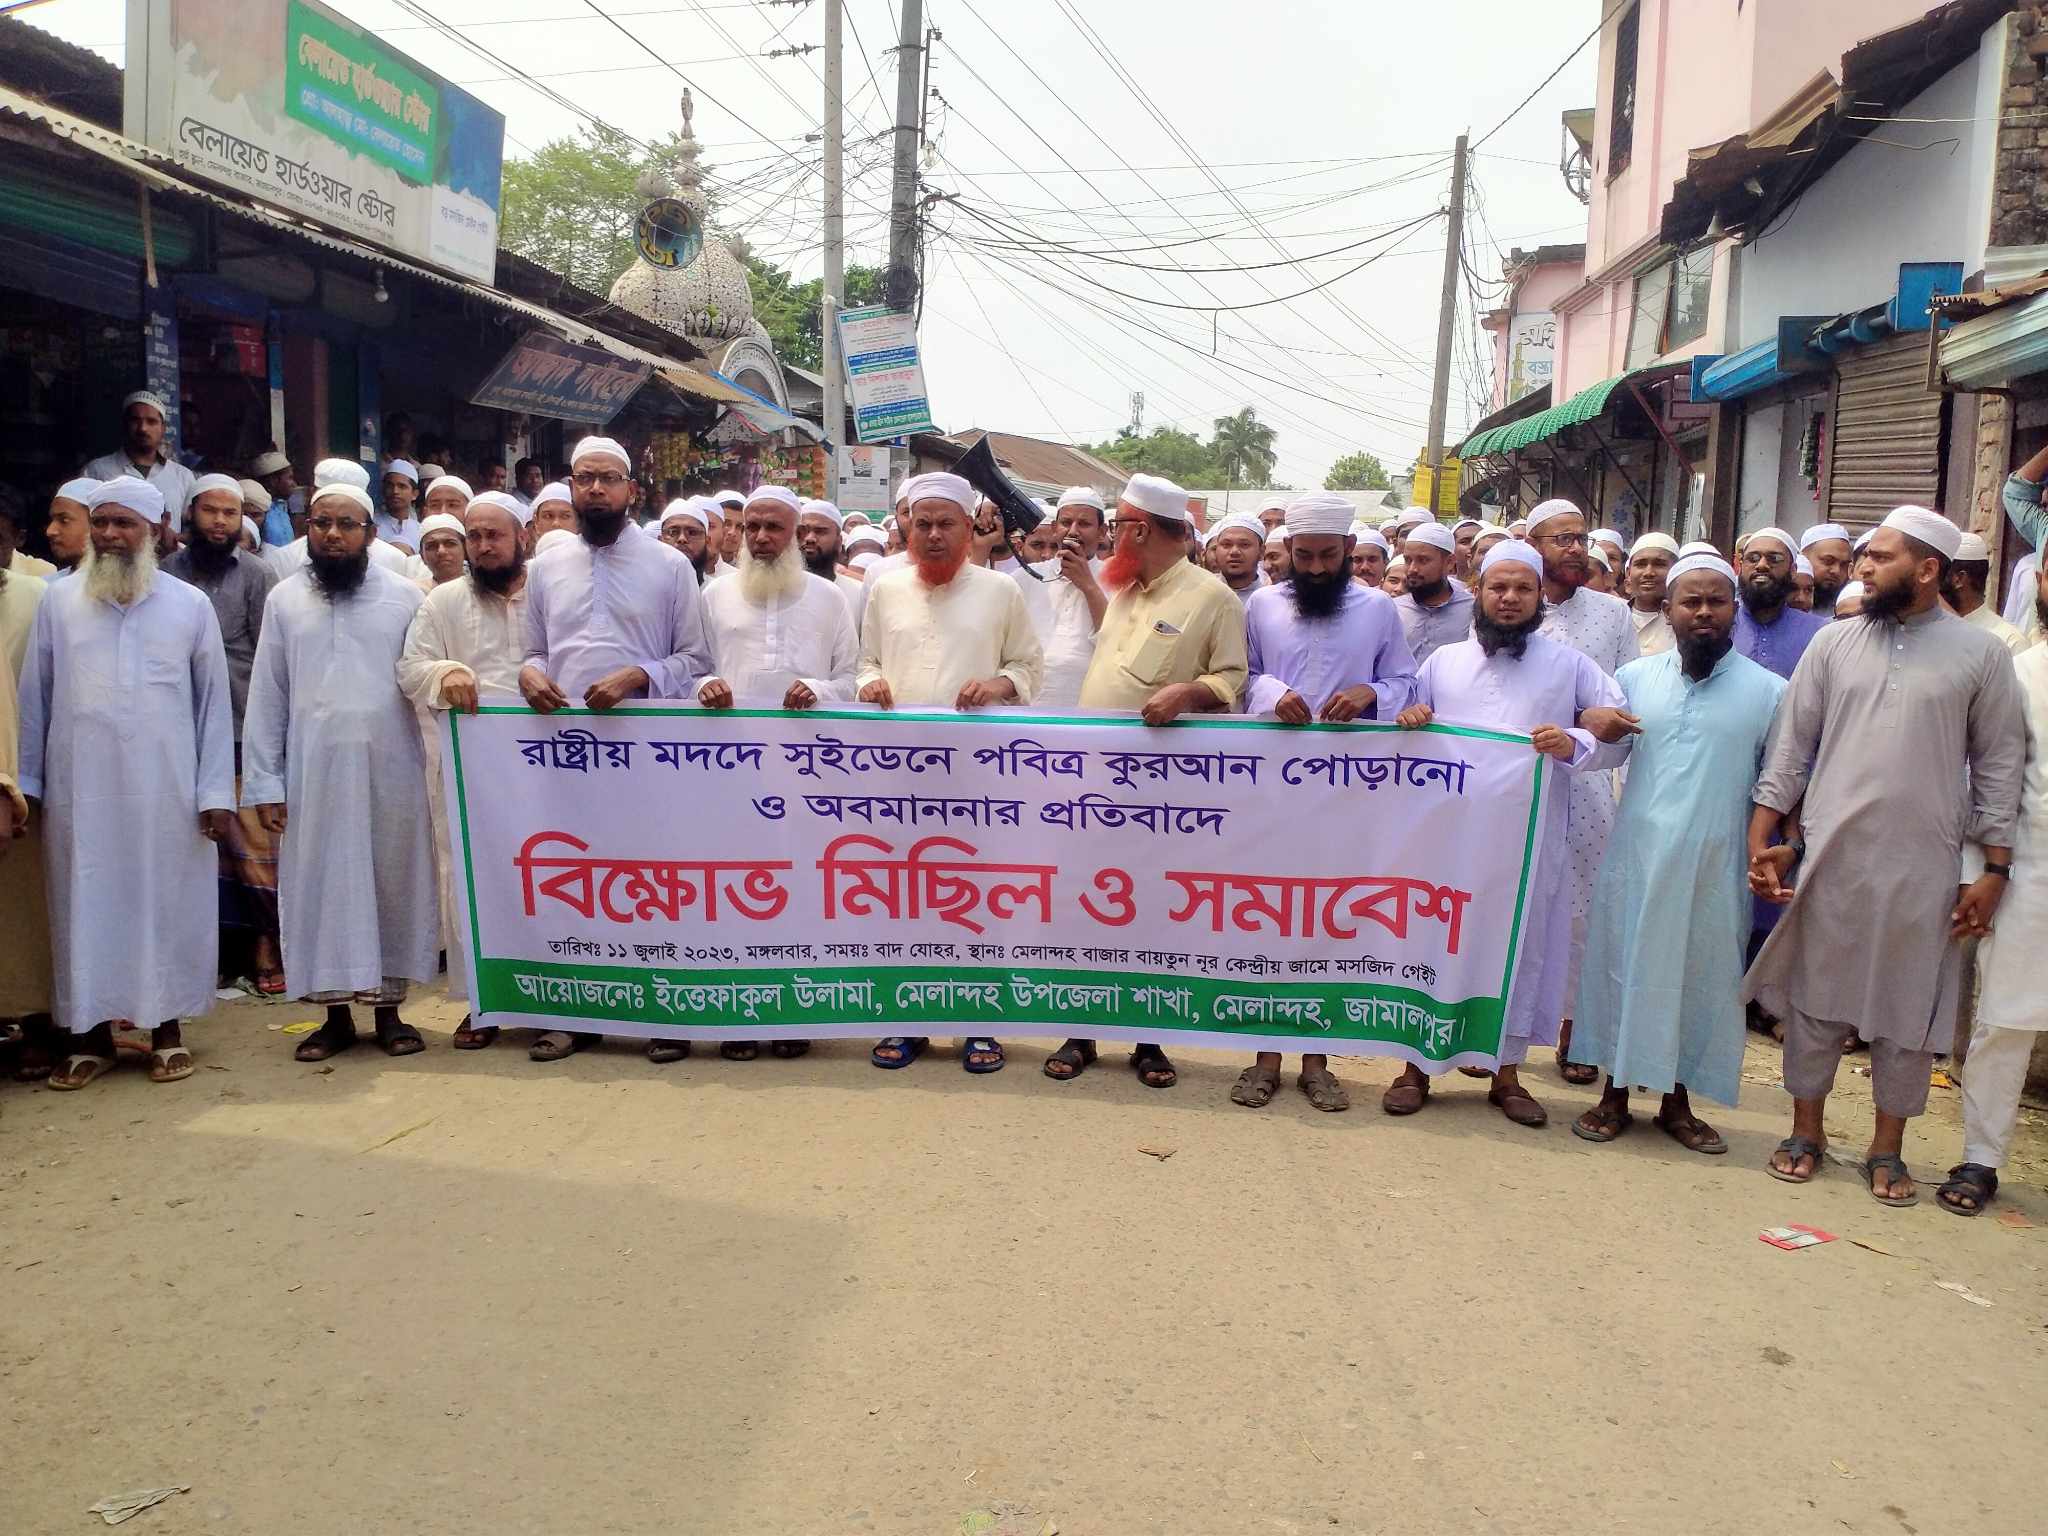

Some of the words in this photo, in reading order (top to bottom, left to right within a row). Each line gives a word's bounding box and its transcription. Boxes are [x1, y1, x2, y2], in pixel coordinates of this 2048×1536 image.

[179, 116, 270, 174] বেলায়েত
[275, 155, 352, 209] হার্ডওয়ার
[516, 729, 637, 773] রাষ্ট্রীয়
[648, 742, 768, 770] মদদে
[780, 734, 958, 779] সুইডেনে
[973, 739, 1088, 778] পবিত্র
[1099, 751, 1266, 790] কুরআন
[1282, 753, 1473, 795] পোড়ানো
[752, 797, 785, 819] ও
[802, 794, 1026, 827] অবমাননার
[1040, 794, 1231, 835] প্রতিবাদে
[514, 832, 792, 924] বিক্ষোভ
[816, 834, 1057, 934] মিছিল
[1079, 868, 1136, 926] ও
[1165, 872, 1472, 955] সমাবেশ
[548, 937, 601, 957] তারিখঃ
[608, 943, 628, 958] ১১
[633, 942, 678, 963] জুলাই
[684, 945, 740, 963] ২০২৩,
[748, 943, 818, 962] মঙ্গলবার,
[824, 943, 868, 959] সময়ঃ
[874, 942, 904, 958] বাদ
[910, 943, 960, 961] যোহর,
[968, 943, 1004, 961] স্থানঃ
[1012, 945, 1076, 963] মেলান্দহ
[1082, 947, 1130, 963] বাজার
[1135, 949, 1189, 971] বায়তুন
[1194, 955, 1220, 974] নূর
[1226, 955, 1283, 976] কেন্দ্রীয়
[1288, 958, 1328, 975] জামে
[1335, 955, 1395, 976] মসজিদ
[1402, 965, 1437, 987] গেইট
[513, 972, 644, 1009] আয়োজনেঃ
[651, 974, 785, 1021] ইত্তেফাকুল
[791, 974, 883, 1015] উলামা,
[896, 978, 1003, 1013] মেলান্দহ
[1009, 974, 1123, 1013] উপজেলা
[1130, 984, 1200, 1024] শাখা,
[1213, 993, 1331, 1031] মেলান্দহ,
